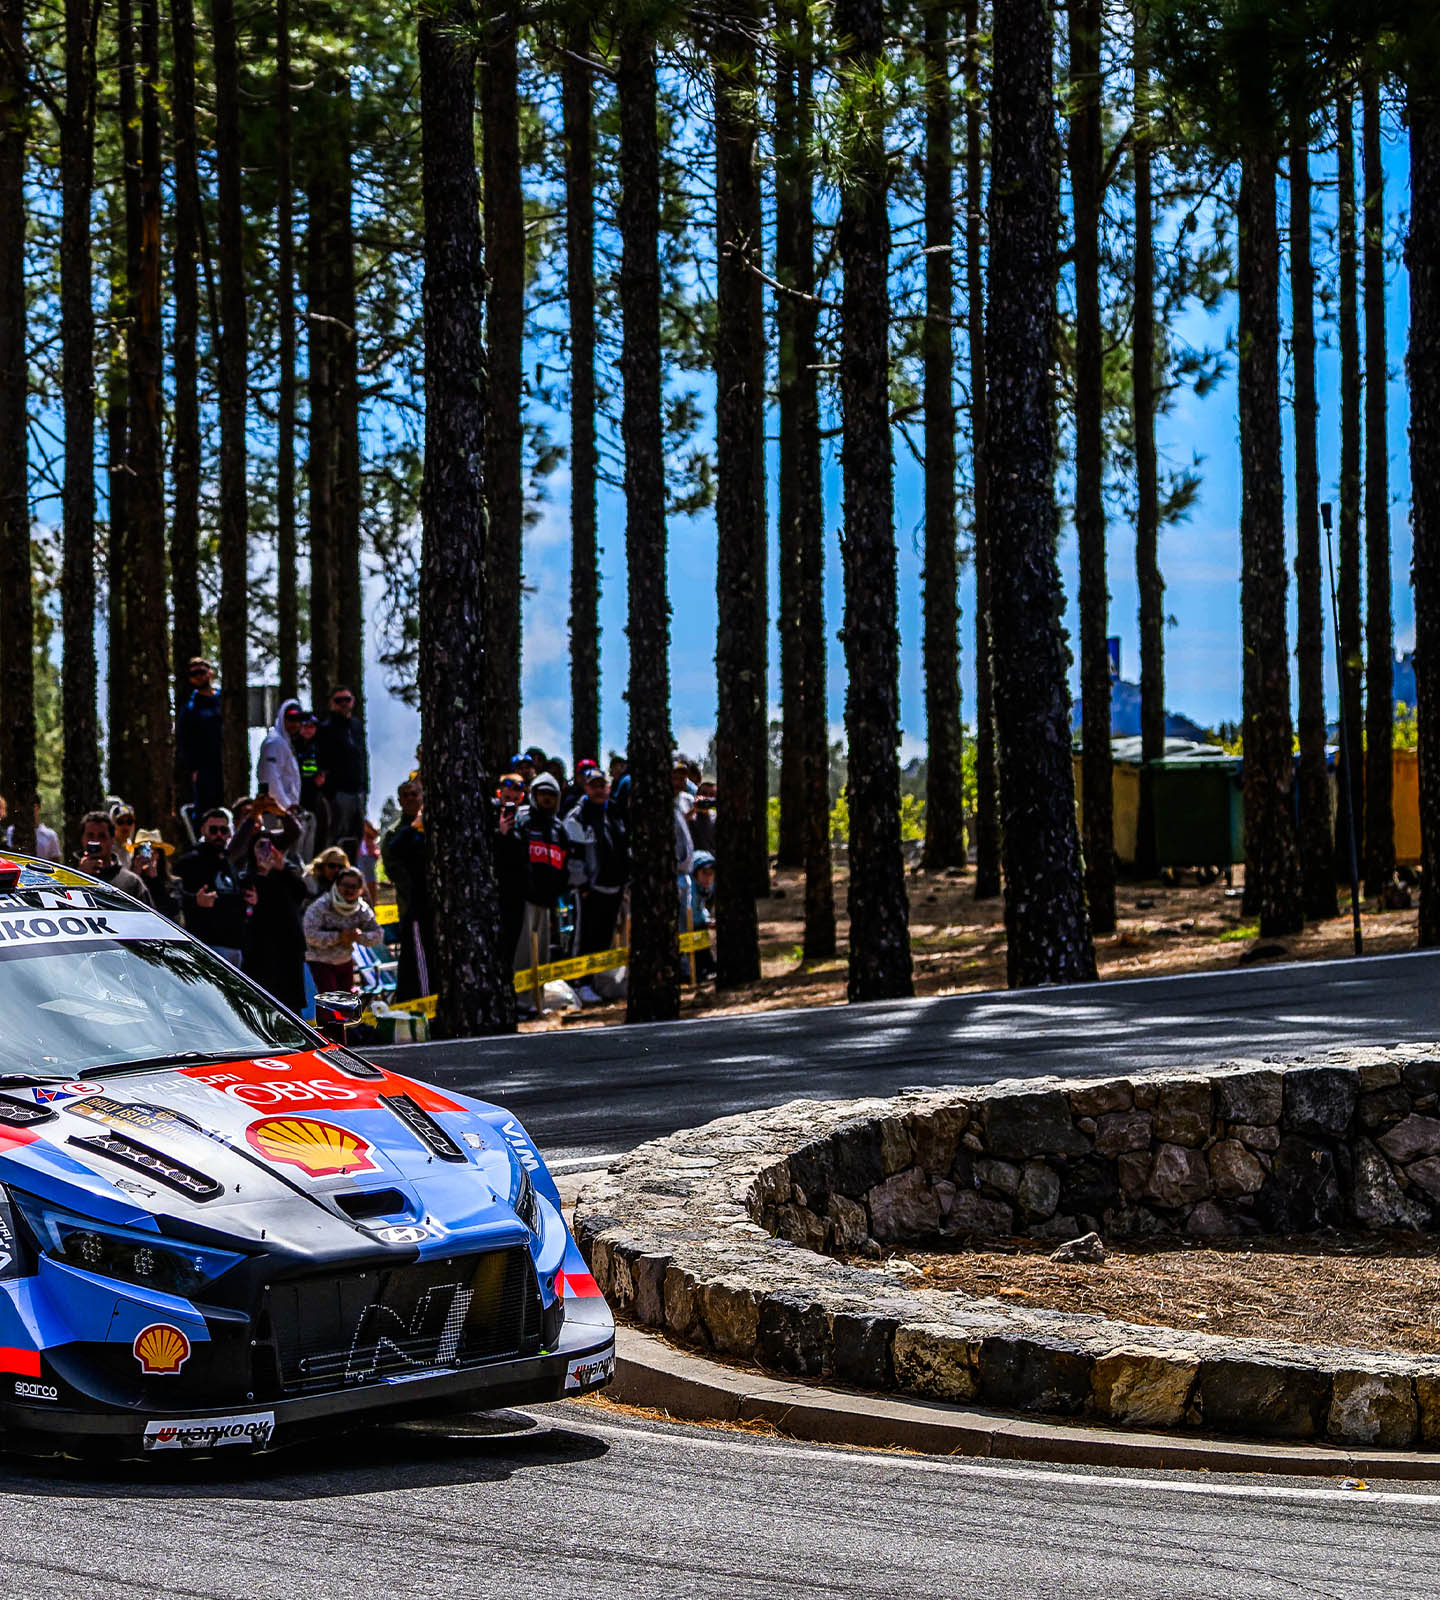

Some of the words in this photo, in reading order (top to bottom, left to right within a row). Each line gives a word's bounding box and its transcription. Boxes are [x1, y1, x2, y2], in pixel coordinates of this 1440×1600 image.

[128, 1073, 245, 1096] HYUNDAI
[84, 1097, 123, 1112] RALLY
[115, 1108, 158, 1127] ISLAS
[15, 1381, 58, 1401] sparco
